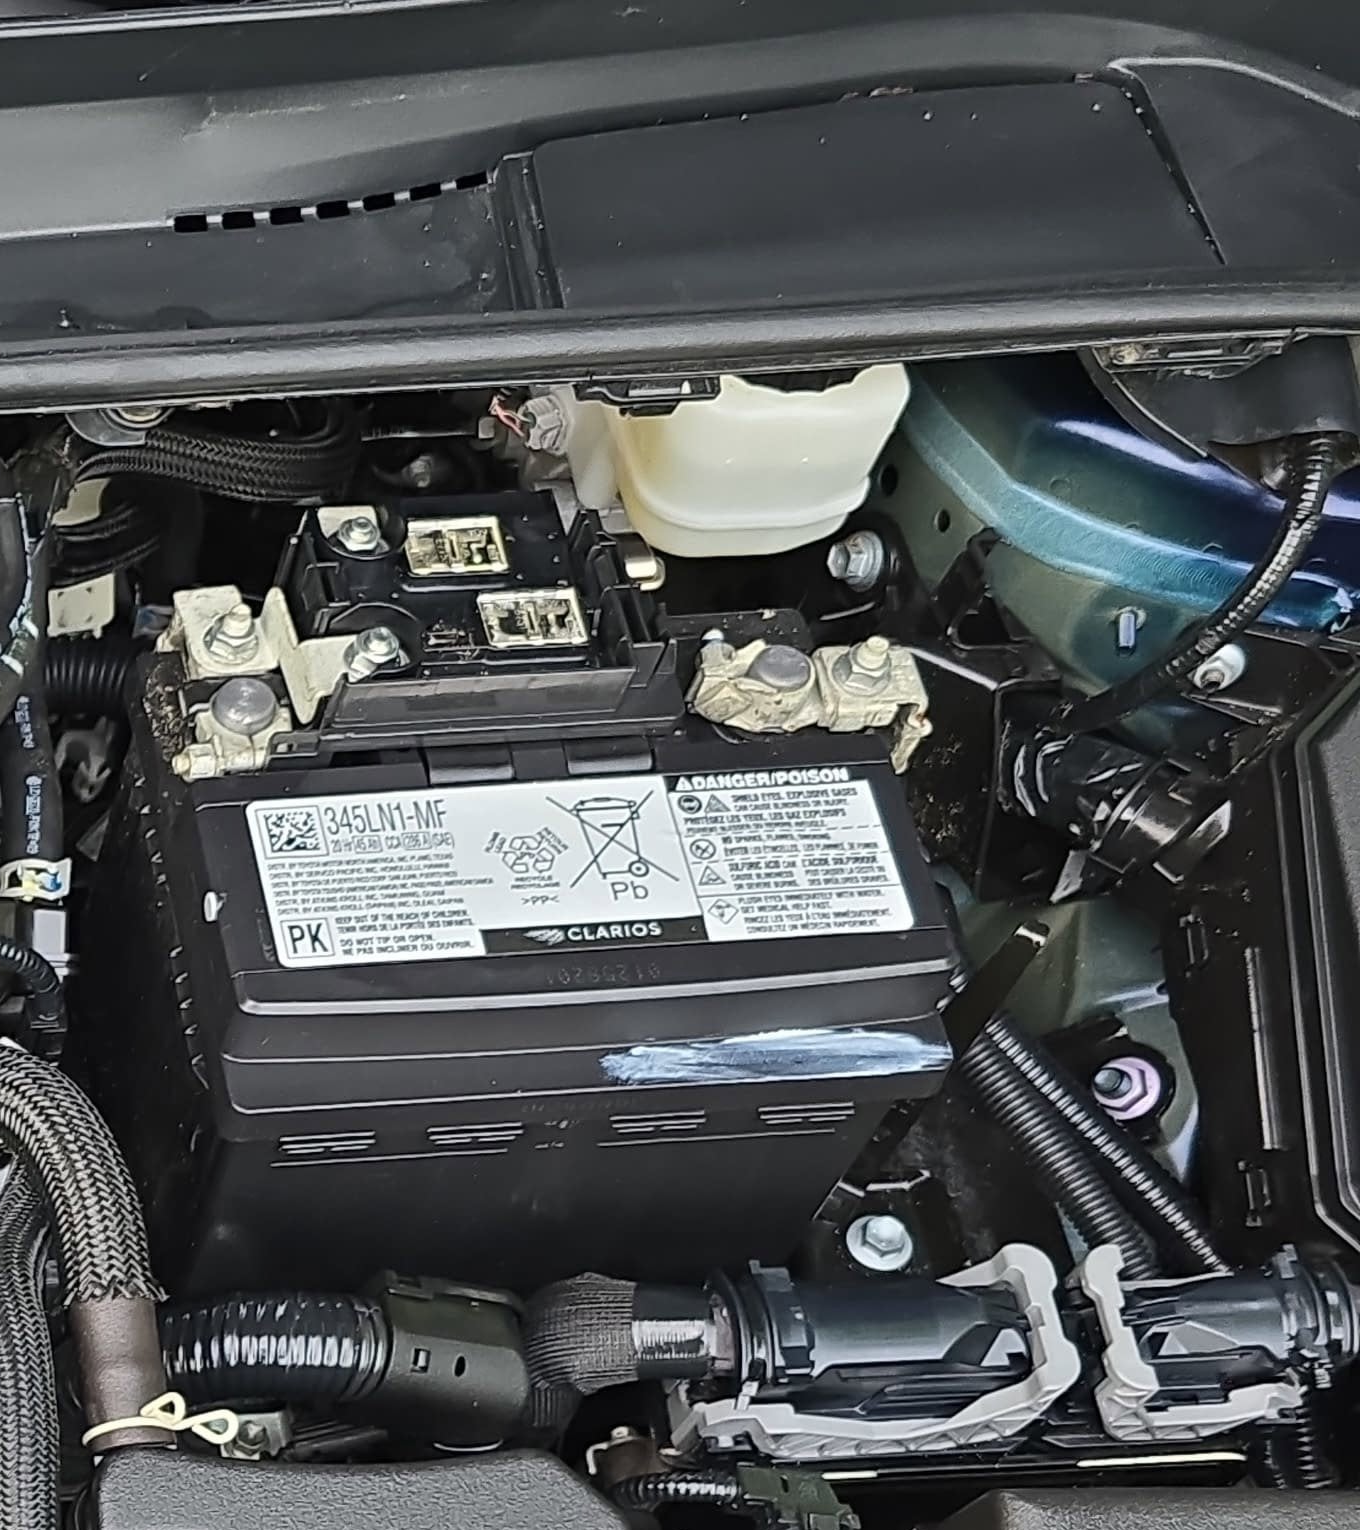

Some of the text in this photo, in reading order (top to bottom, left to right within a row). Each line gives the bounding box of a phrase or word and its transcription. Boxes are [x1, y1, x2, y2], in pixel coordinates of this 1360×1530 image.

[691, 768, 849, 790] DANGER/POISON
[324, 799, 447, 835] 345LN1-MF
[610, 882, 648, 901] Pb
[287, 922, 328, 955] PK
[567, 922, 663, 942] CLARIOS
